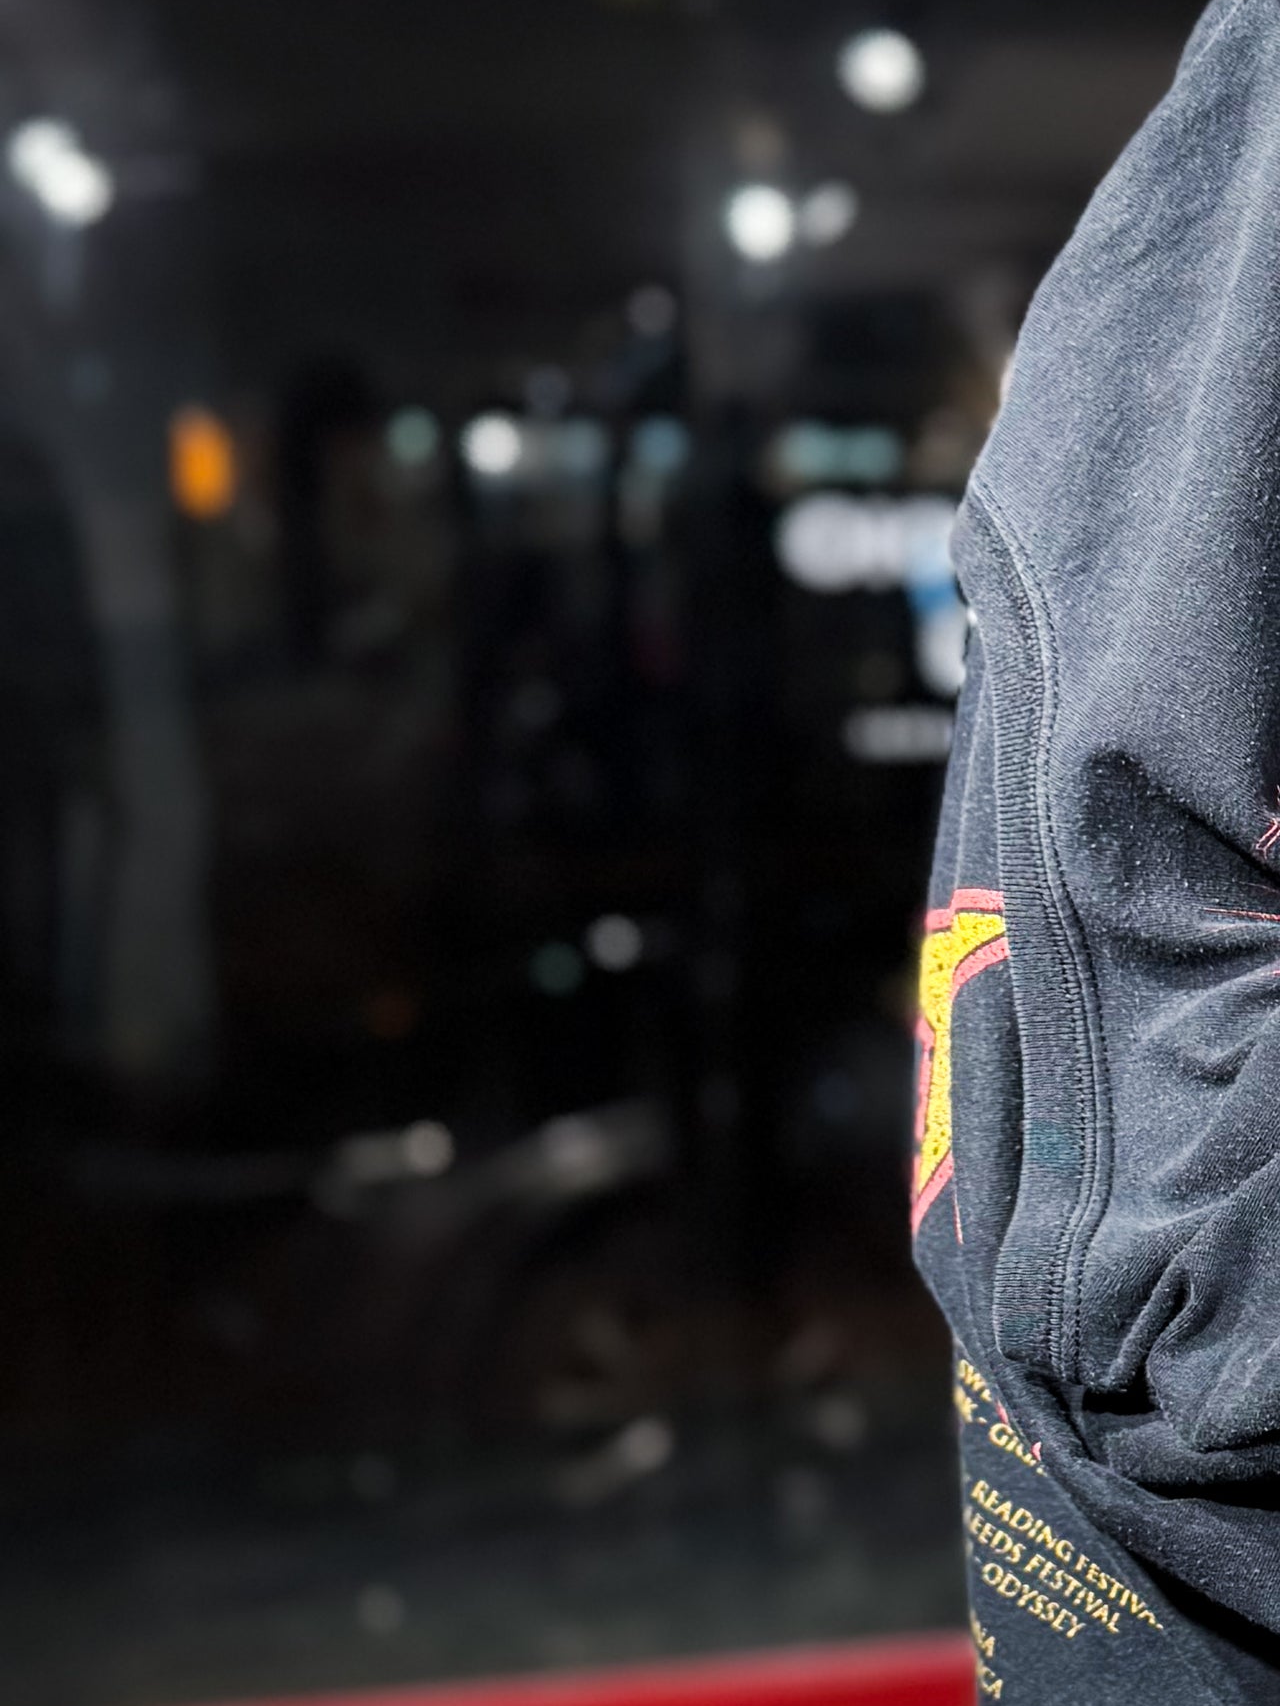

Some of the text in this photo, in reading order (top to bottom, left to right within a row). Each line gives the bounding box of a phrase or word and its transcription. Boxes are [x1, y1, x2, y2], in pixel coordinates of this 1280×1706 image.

[970, 1479, 1075, 1563] READING
[980, 1562, 1087, 1639] ODYSSEY
[1023, 1553, 1121, 1634] FESTIVAL
